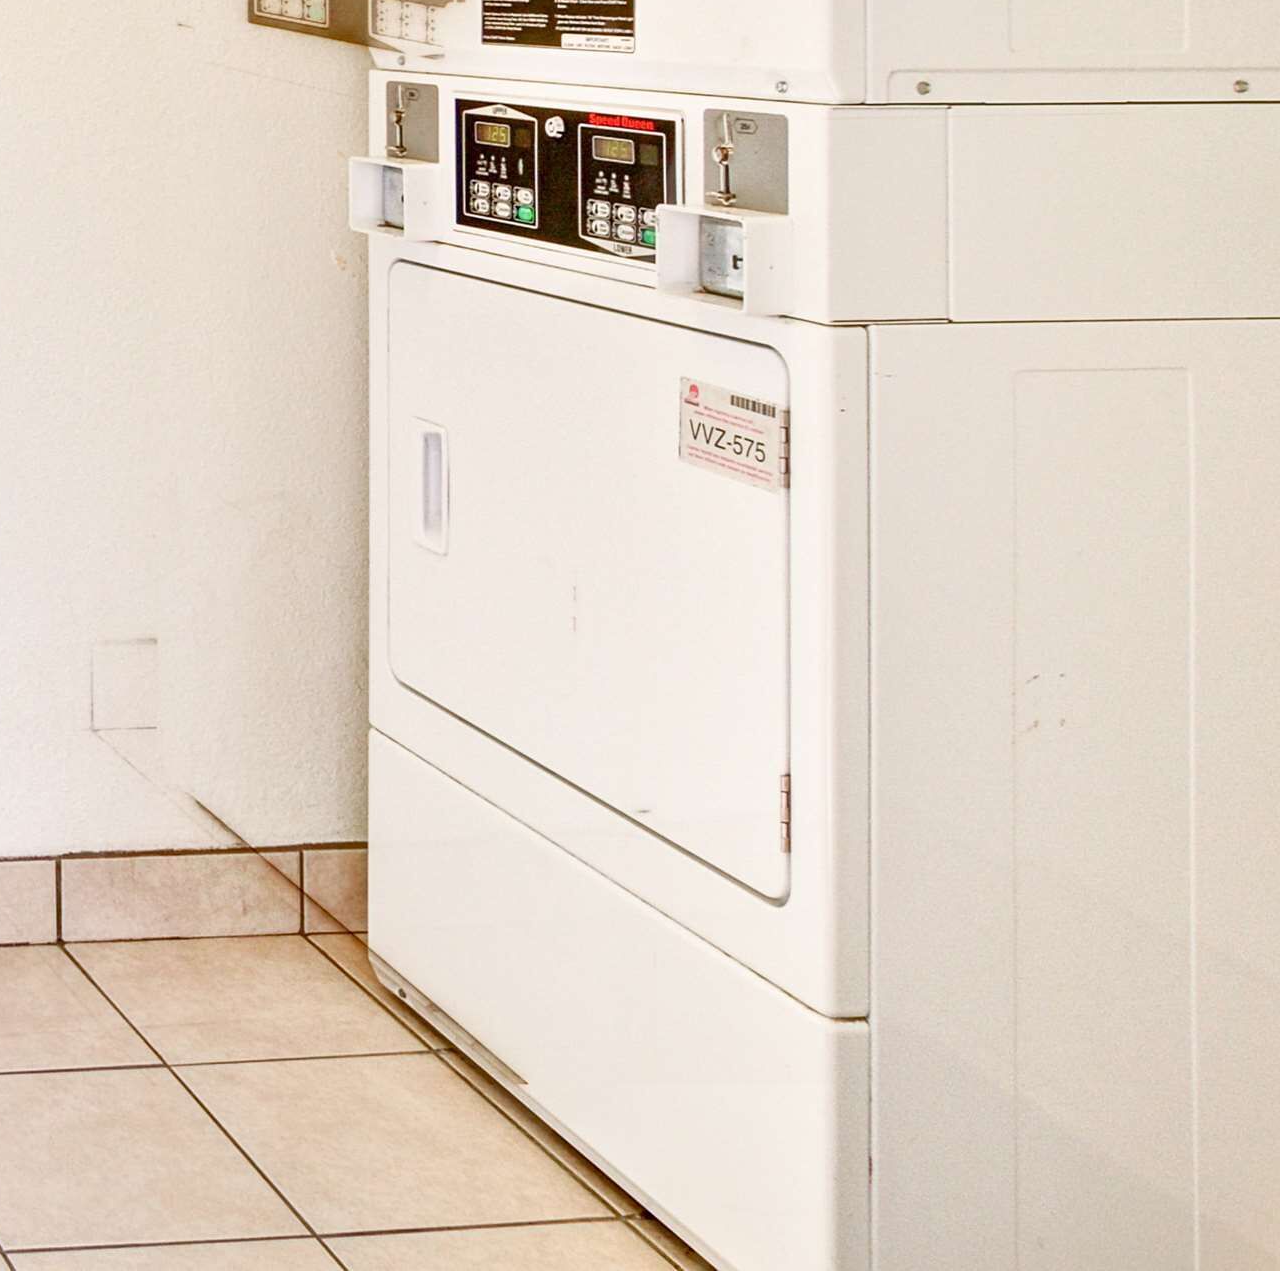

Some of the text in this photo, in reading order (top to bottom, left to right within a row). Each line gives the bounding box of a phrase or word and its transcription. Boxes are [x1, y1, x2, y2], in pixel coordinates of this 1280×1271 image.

[589, 113, 655, 130] Speed Queen
[613, 244, 633, 254] LOWER
[689, 419, 765, 462] VVZ-575
